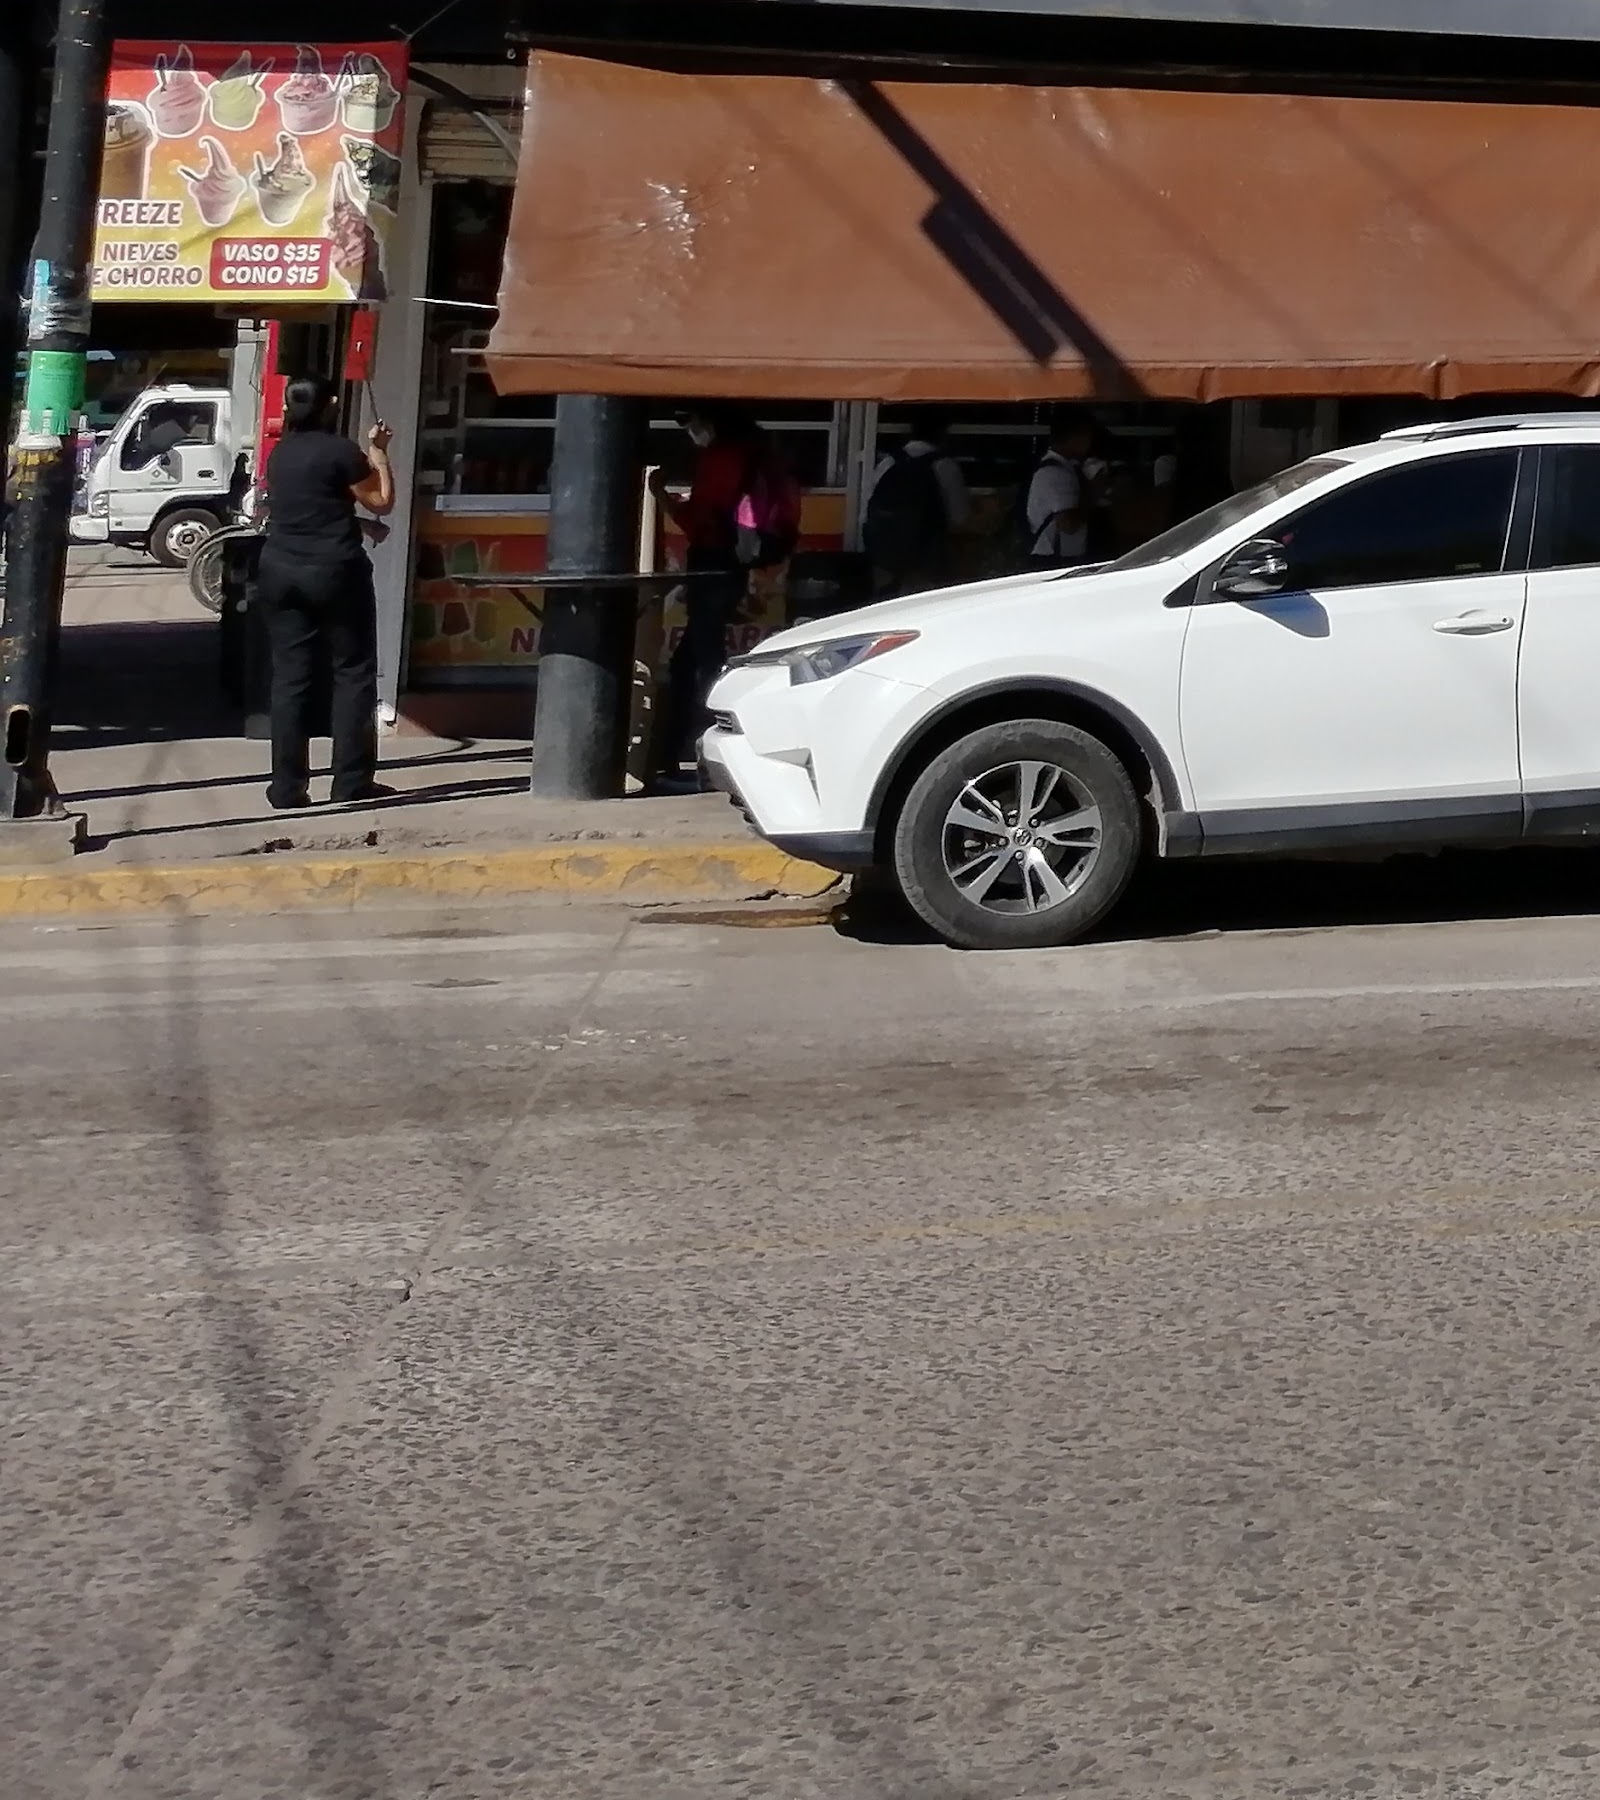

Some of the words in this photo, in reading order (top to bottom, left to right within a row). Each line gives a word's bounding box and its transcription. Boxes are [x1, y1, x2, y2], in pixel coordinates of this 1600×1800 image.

[99, 202, 181, 225] REEZE
[103, 243, 179, 262] NIEVES
[224, 244, 281, 262] VASO
[283, 243, 322, 264] $35
[107, 267, 202, 286] CHORRO
[221, 266, 282, 284] CONO
[286, 265, 320, 286] $15
